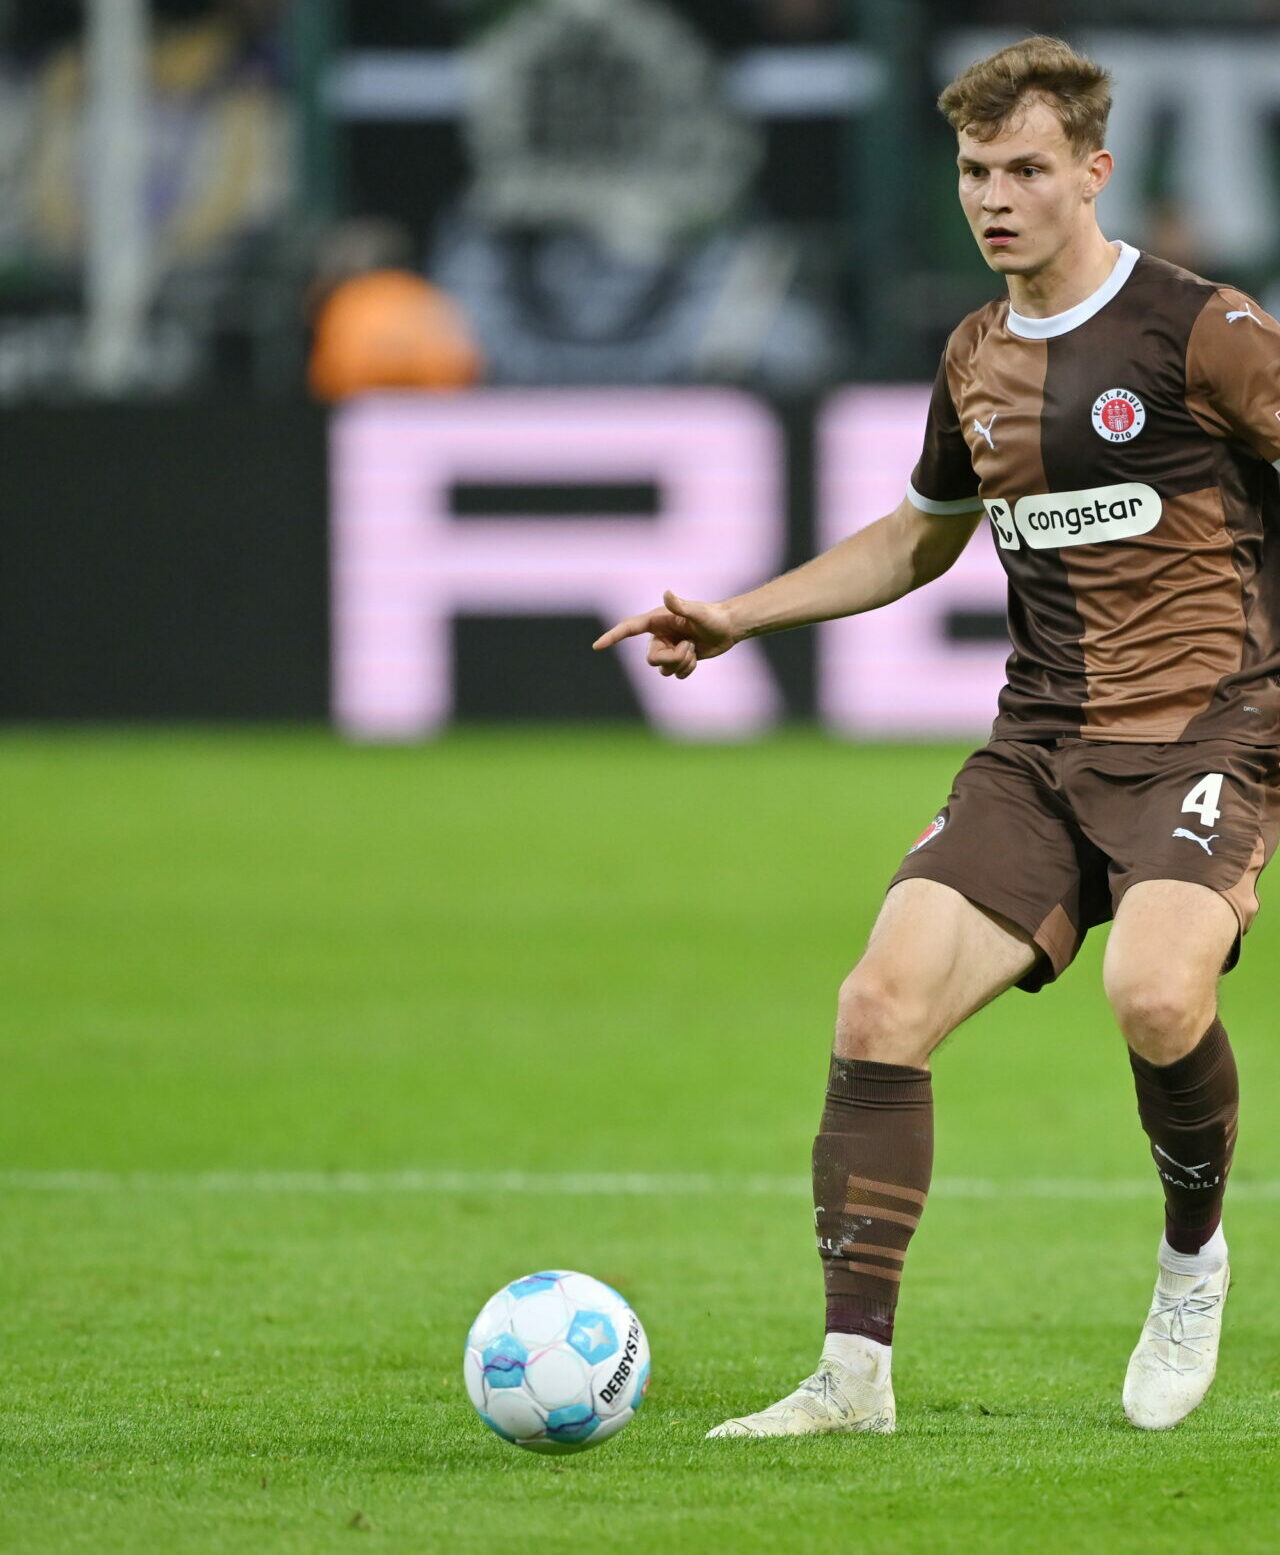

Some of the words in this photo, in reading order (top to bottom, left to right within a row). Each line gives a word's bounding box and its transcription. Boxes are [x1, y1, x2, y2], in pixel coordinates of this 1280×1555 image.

[1093, 404, 1102, 416] FC
[1101, 393, 1113, 404] ST.
[1116, 390, 1143, 413] PAULI
[1110, 431, 1132, 441] 1910
[1028, 498, 1143, 535] congstar
[1181, 773, 1224, 827] 4
